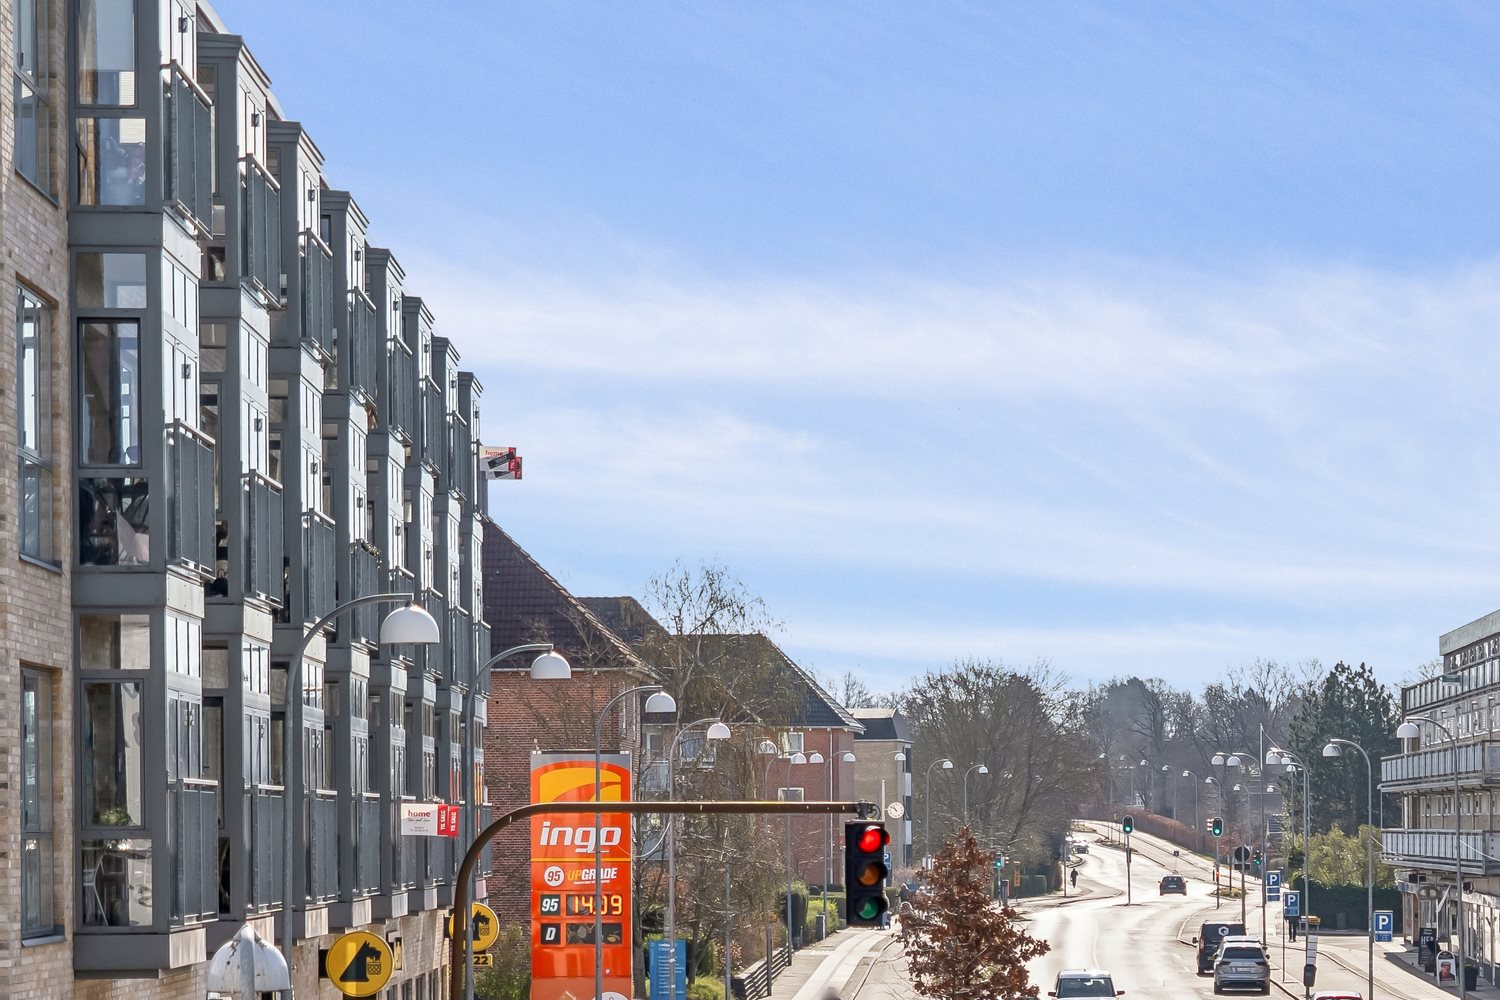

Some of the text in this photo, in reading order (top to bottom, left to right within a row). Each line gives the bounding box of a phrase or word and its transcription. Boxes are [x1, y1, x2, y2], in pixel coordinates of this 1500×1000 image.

[540, 822, 622, 853] ingo
[547, 870, 561, 882] 95
[1270, 875, 1278, 885] P
[542, 898, 558, 912] 95
[1288, 895, 1296, 906] P
[1378, 916, 1388, 930] P
[546, 927, 556, 940] D
